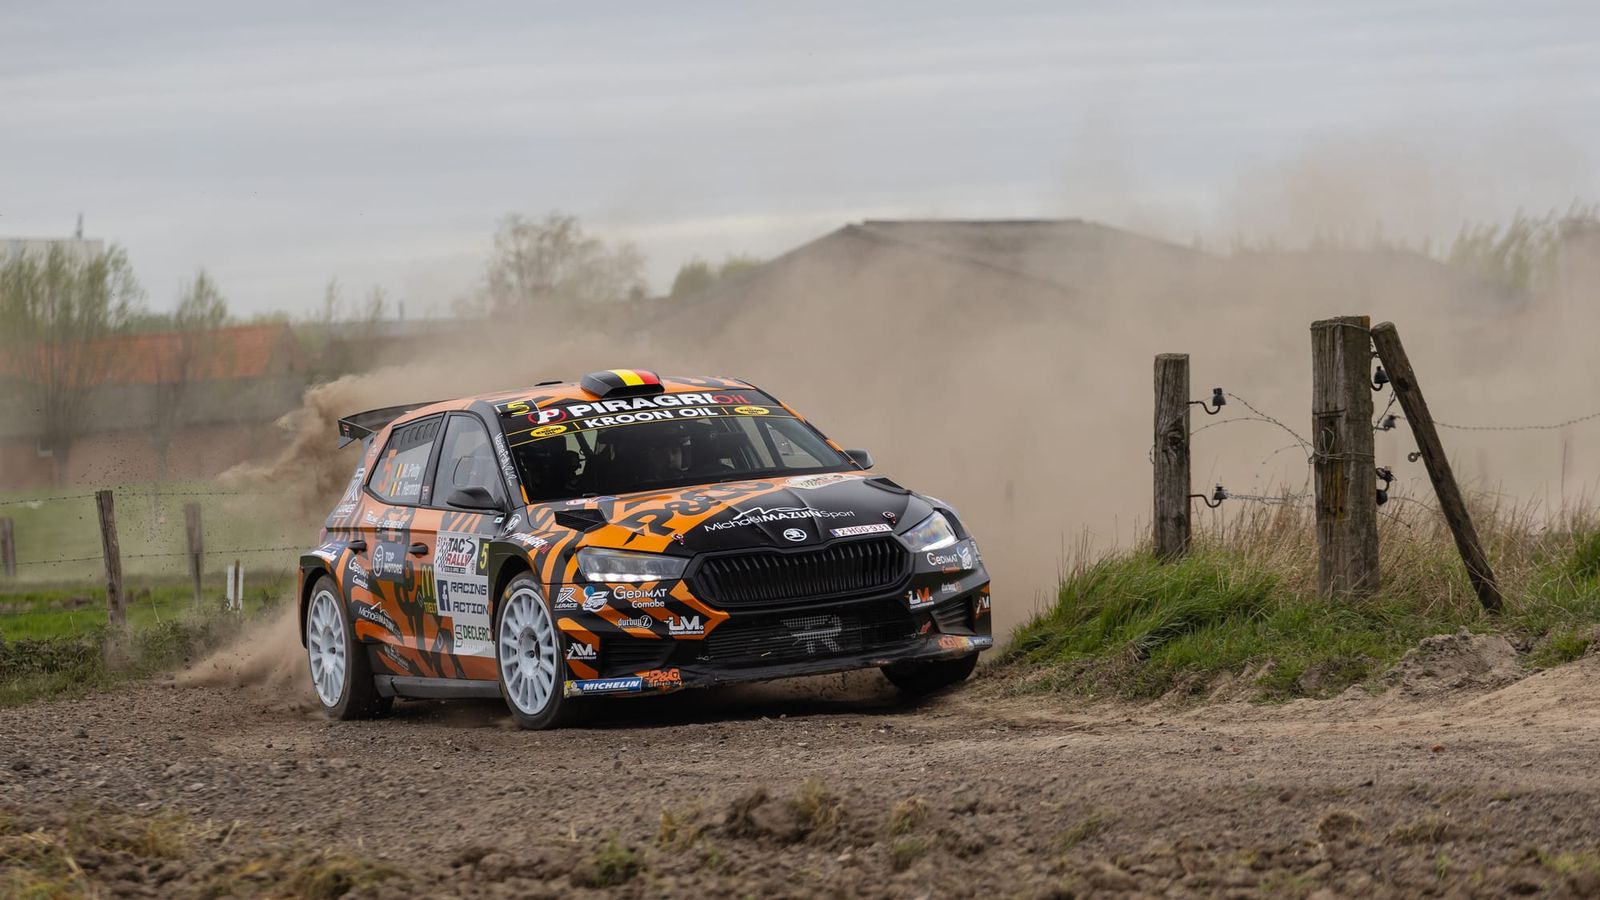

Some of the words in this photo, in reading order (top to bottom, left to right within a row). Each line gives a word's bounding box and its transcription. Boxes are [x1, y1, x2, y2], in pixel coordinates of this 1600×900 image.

[507, 401, 530, 415] 5
[584, 409, 674, 428] KROON
[679, 408, 719, 417] OIL
[449, 538, 466, 554] TAC
[385, 551, 395, 562] TOP
[446, 552, 472, 567] RALLY
[480, 543, 489, 569] 5
[384, 563, 403, 574] MOTORS
[450, 582, 488, 596] RACING
[453, 601, 489, 615] ACTION
[631, 599, 665, 609] Comobe
[583, 681, 640, 691] MICHELIN
